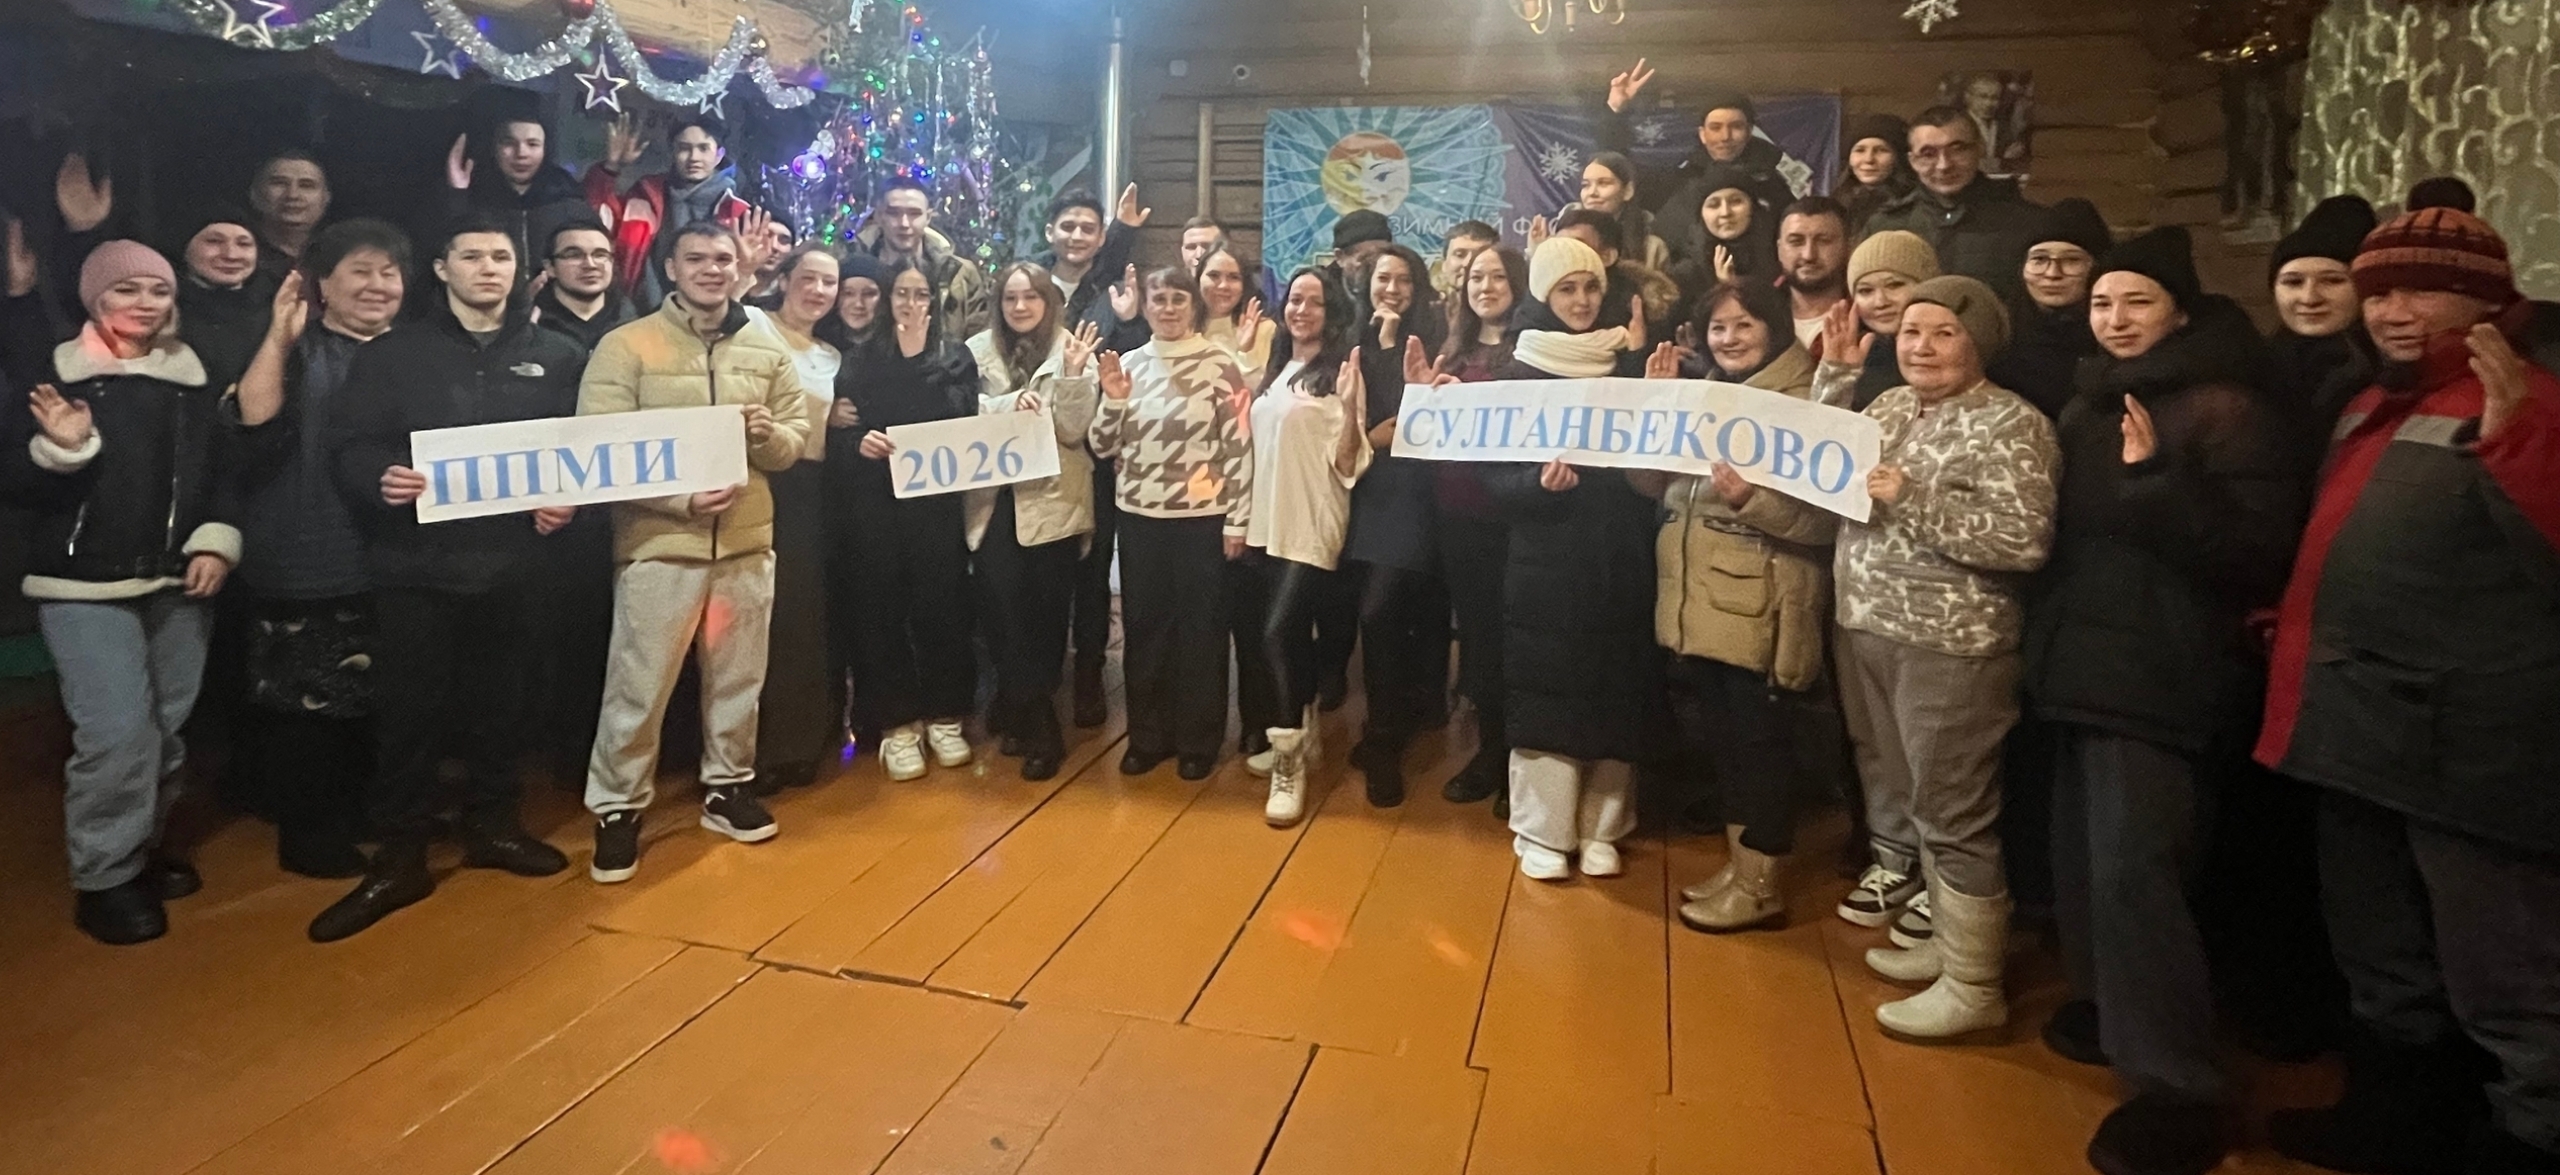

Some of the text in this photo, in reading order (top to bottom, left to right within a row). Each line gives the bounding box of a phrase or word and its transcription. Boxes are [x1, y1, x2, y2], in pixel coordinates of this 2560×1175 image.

[426, 437, 681, 507] ППМИ
[900, 436, 1023, 491] 2026
[1402, 405, 1855, 494] СУЛТАНБЕКОВО
